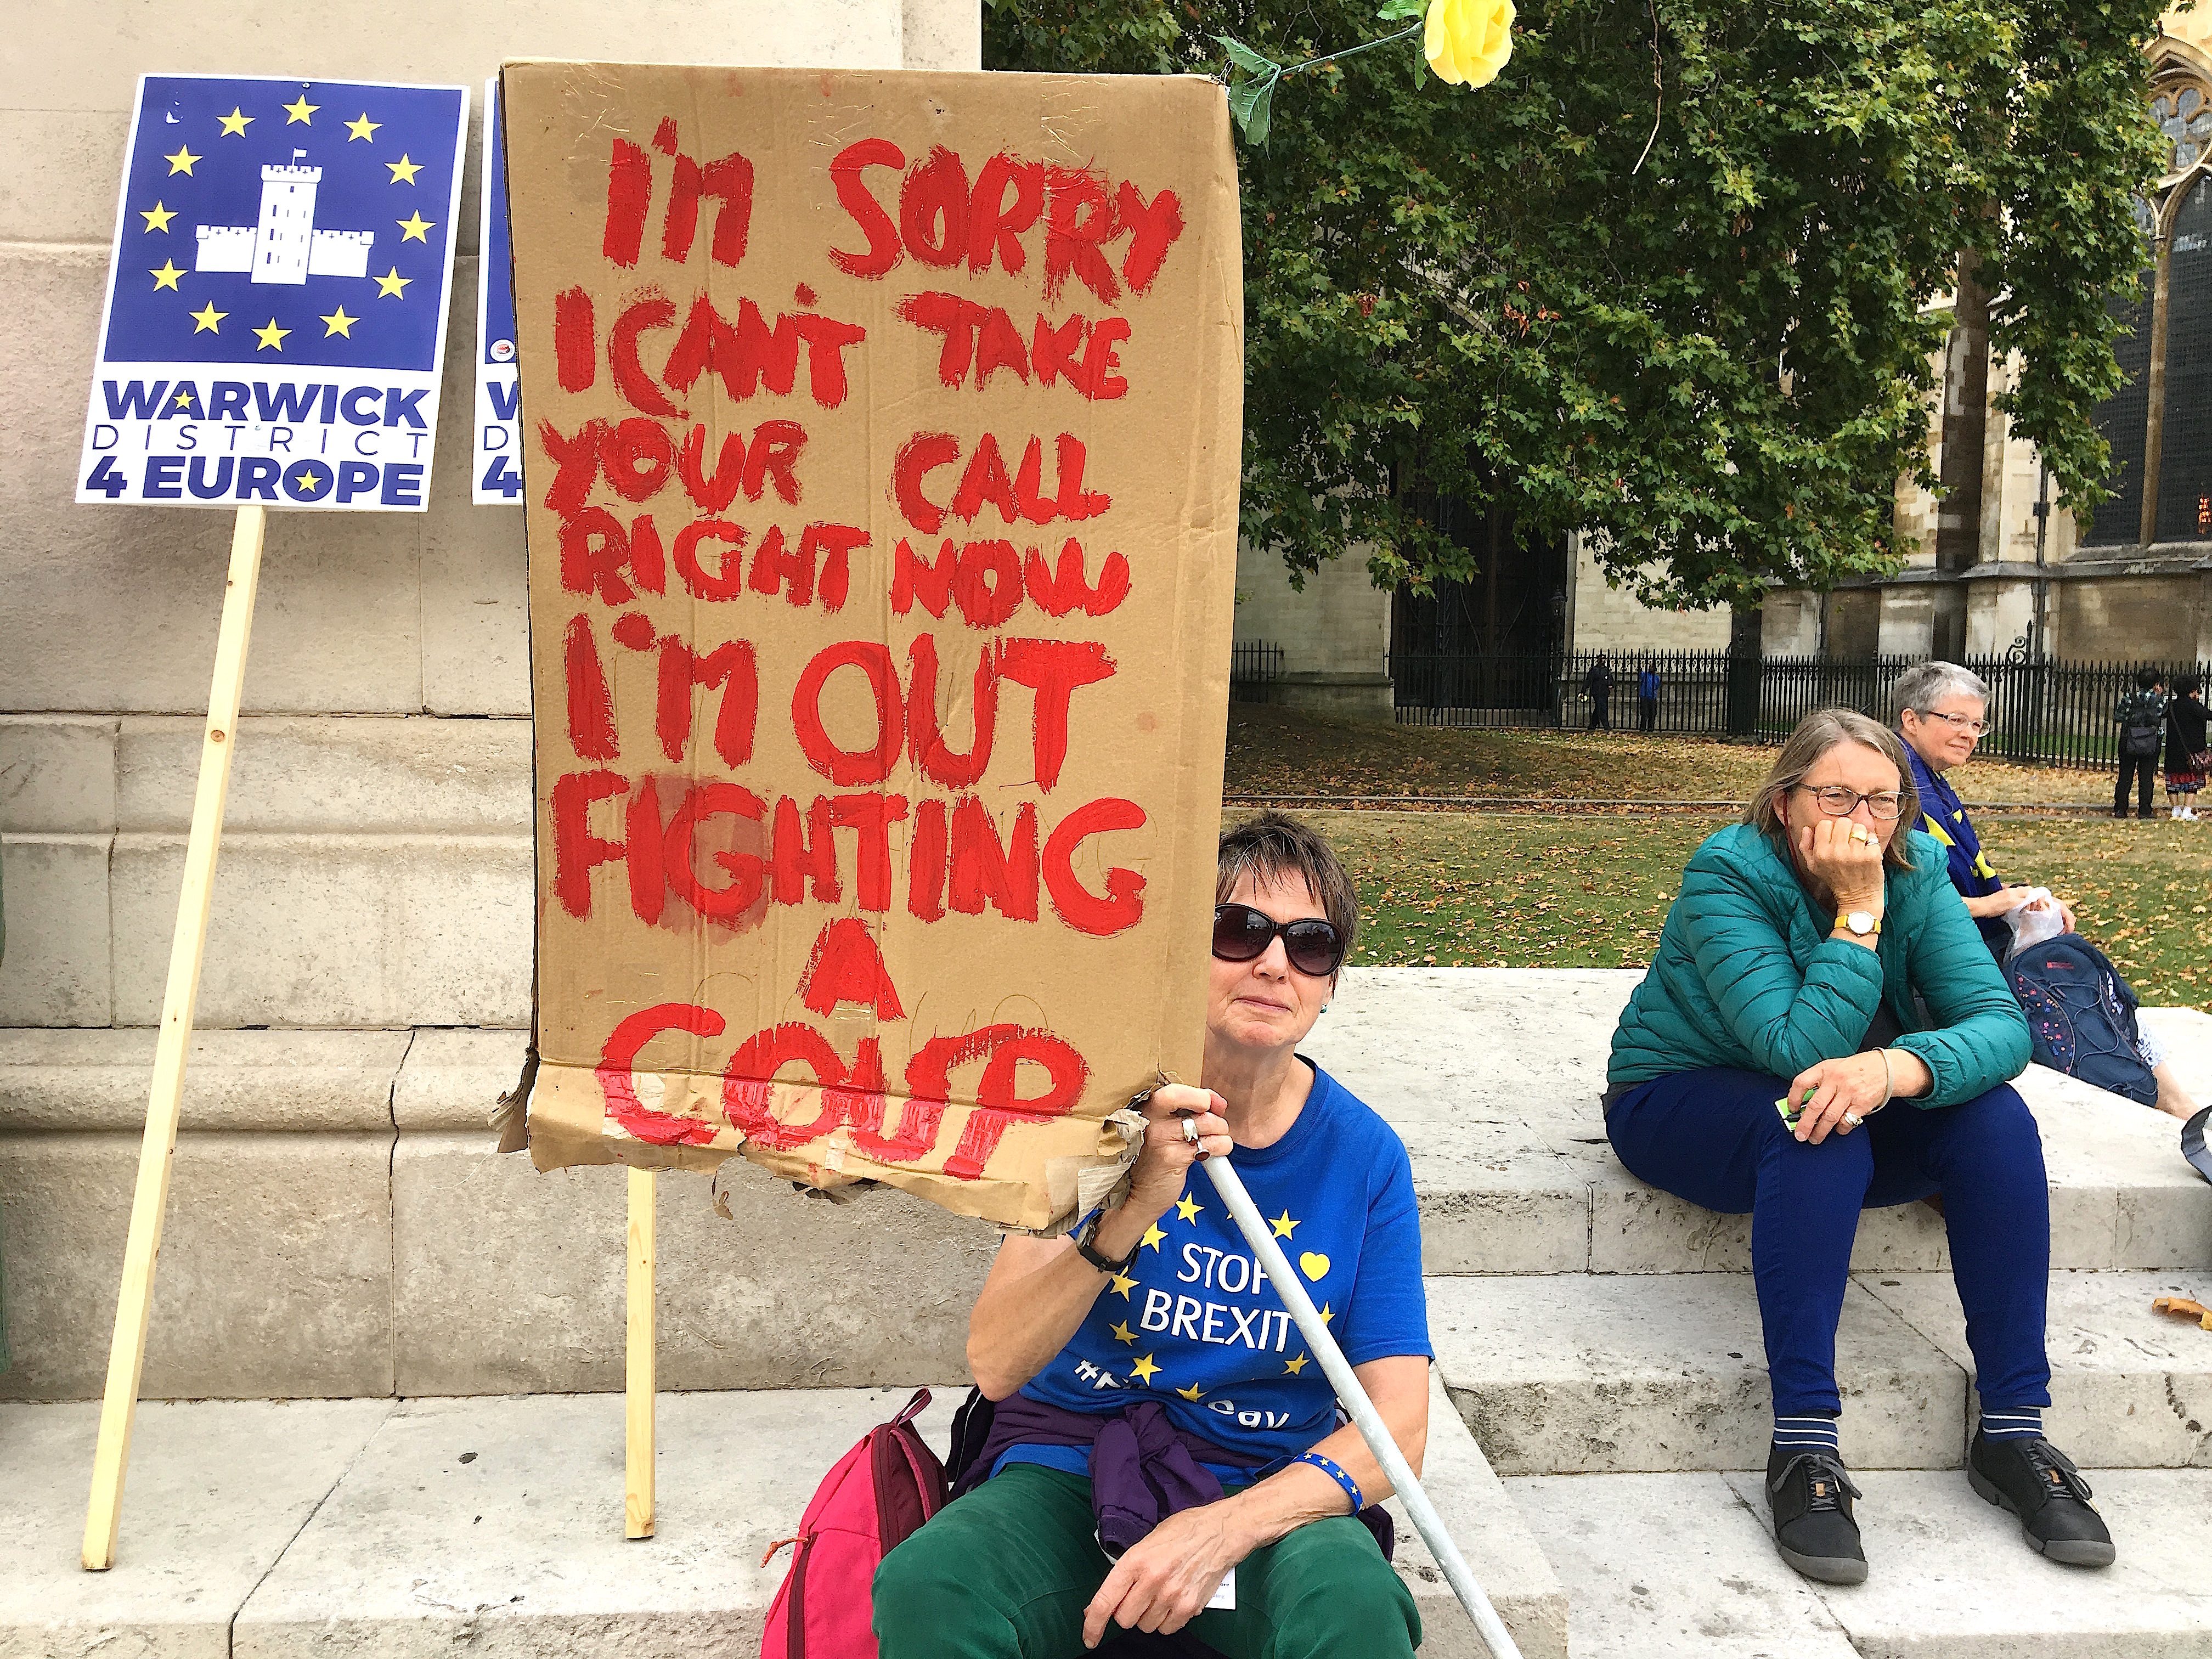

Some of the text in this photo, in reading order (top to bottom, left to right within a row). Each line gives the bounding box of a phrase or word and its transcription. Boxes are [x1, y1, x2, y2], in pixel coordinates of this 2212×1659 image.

[828, 138, 1185, 307] SORRY
[103, 381, 431, 430] WARWICK
[555, 282, 1132, 420] I CAN'T TAKE
[86, 456, 424, 506] 4 EUROPE
[92, 424, 428, 459] DISTRICT
[538, 417, 1113, 535] YOUR CALL
[557, 506, 1132, 630] RIGHT NOW
[791, 633, 1118, 794] OUT
[550, 769, 1148, 937] FIGHTING
[796, 917, 907, 1022] A
[594, 1002, 1094, 1182] COUP
[1140, 1288, 1294, 1352] BREXIT
